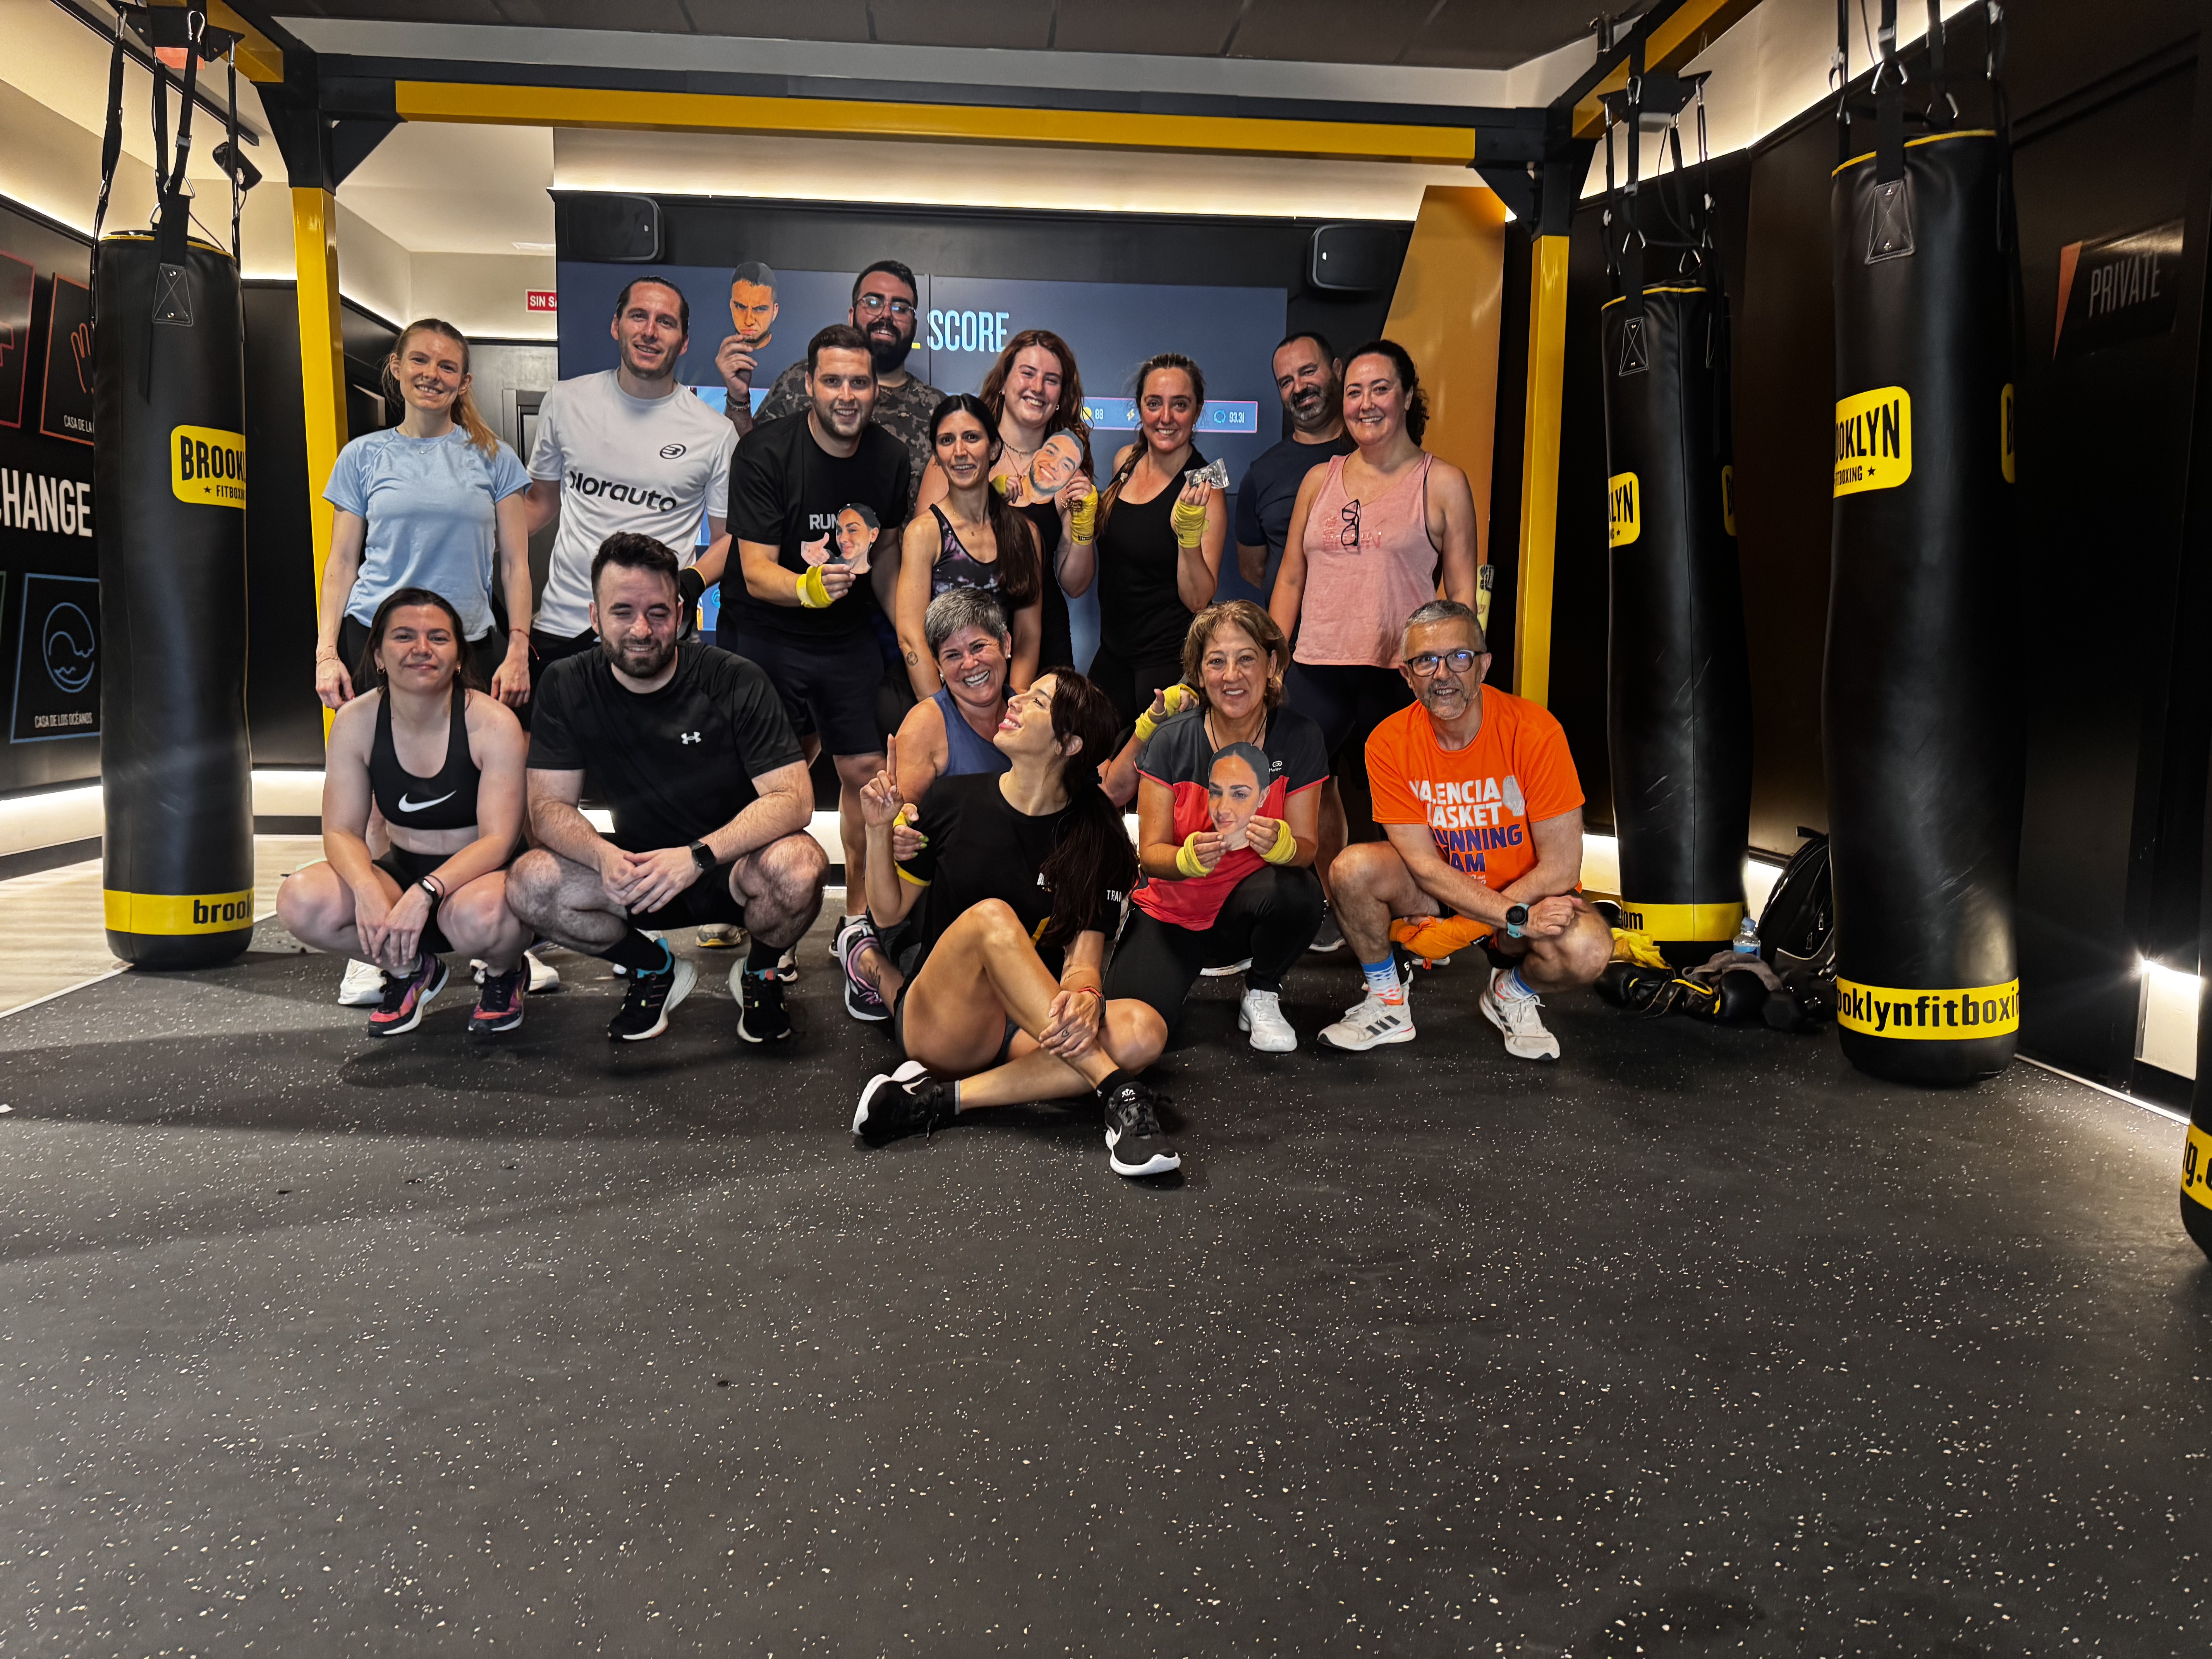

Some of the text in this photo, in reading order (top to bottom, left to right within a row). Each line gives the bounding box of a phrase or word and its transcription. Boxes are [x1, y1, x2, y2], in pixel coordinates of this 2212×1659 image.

[2089, 251, 2160, 318] PRIVATE
[530, 295, 545, 307] SIN
[927, 309, 1009, 352] SCORE
[64, 415, 77, 429] CASA
[78, 419, 85, 431] DE
[86, 421, 92, 433] LA
[1095, 409, 1103, 419] 88
[180, 435, 246, 483] BROOK
[0, 467, 92, 537] HANGE
[1609, 480, 1633, 523] LYN
[1434, 824, 1523, 852] UNNING
[1107, 890, 1122, 902] TRAI
[1621, 910, 1643, 930] om
